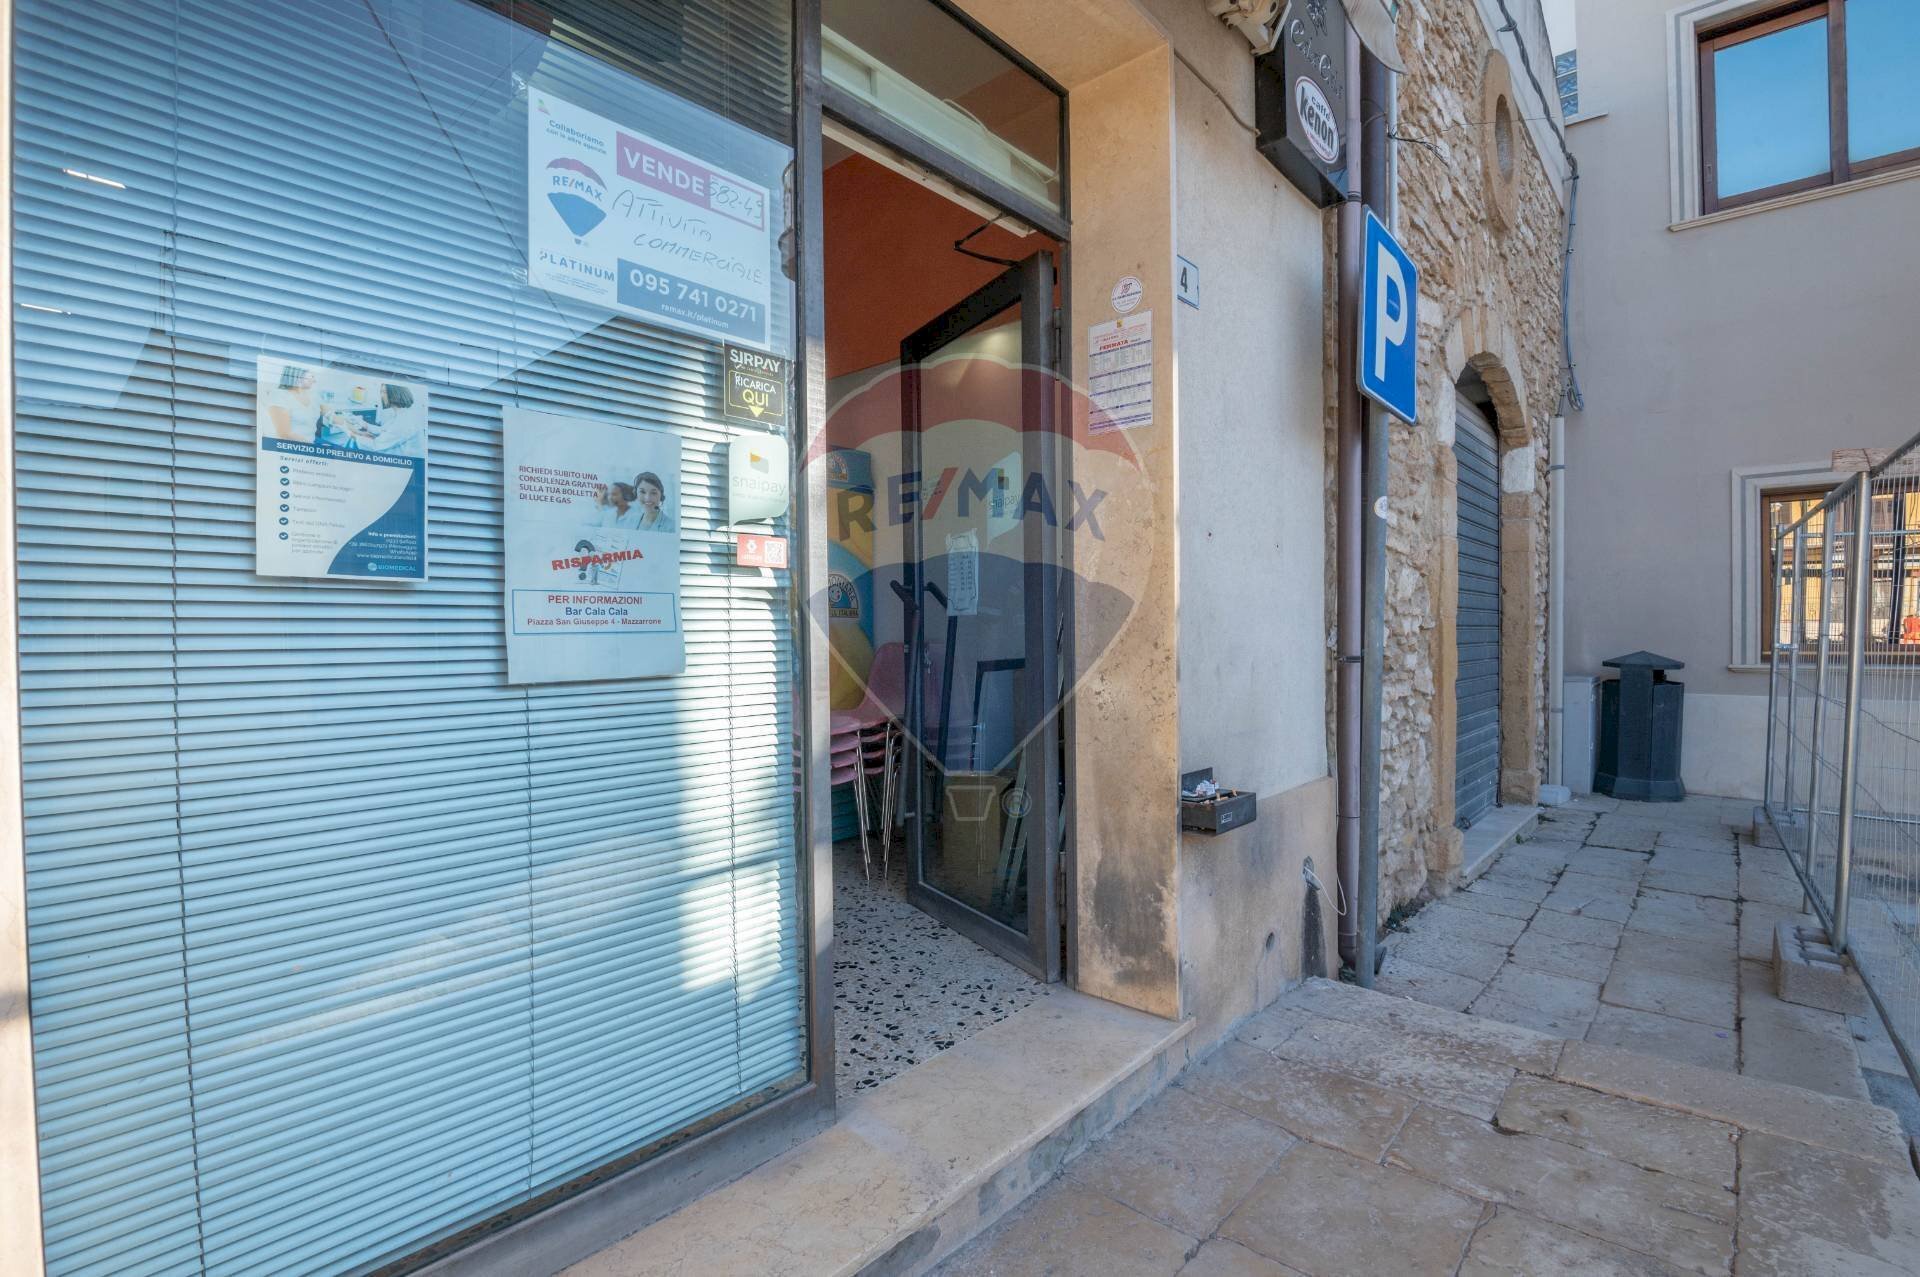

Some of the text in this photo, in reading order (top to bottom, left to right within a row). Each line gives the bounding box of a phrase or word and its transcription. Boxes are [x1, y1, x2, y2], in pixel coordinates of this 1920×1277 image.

[549, 120, 605, 146] Collaboriamo
[623, 146, 705, 197] VENDE
[552, 175, 603, 202] RE/MAX
[1180, 267, 1188, 293] 4
[630, 269, 670, 295] 095
[676, 283, 708, 307] 741
[715, 295, 757, 322] 0271
[661, 303, 729, 329] remax.it/platinum
[1375, 241, 1408, 382] P
[730, 349, 781, 373] SIRPAY
[735, 374, 777, 394] RICARICA
[742, 388, 769, 407] QUI
[276, 442, 315, 453] SERVIZIO
[326, 448, 364, 460] PRELIEVO
[372, 455, 413, 466] DOMICILIO
[519, 465, 598, 481] RICHIEDI SUBITO UNA
[519, 474, 608, 490] CONSULENZA GRATUITA
[519, 483, 598, 498] SULLA TUA BOLLETTA
[732, 476, 787, 496] snaipay
[528, 494, 549, 502] LUCE
[555, 496, 572, 504] GAS
[551, 549, 644, 571] RISPARMIA
[548, 594, 643, 605] PER INFORMAZIONI
[565, 607, 628, 616] Bar Cala Cala
[527, 618, 554, 626] Piazza
[573, 618, 609, 627] Giuseppe
